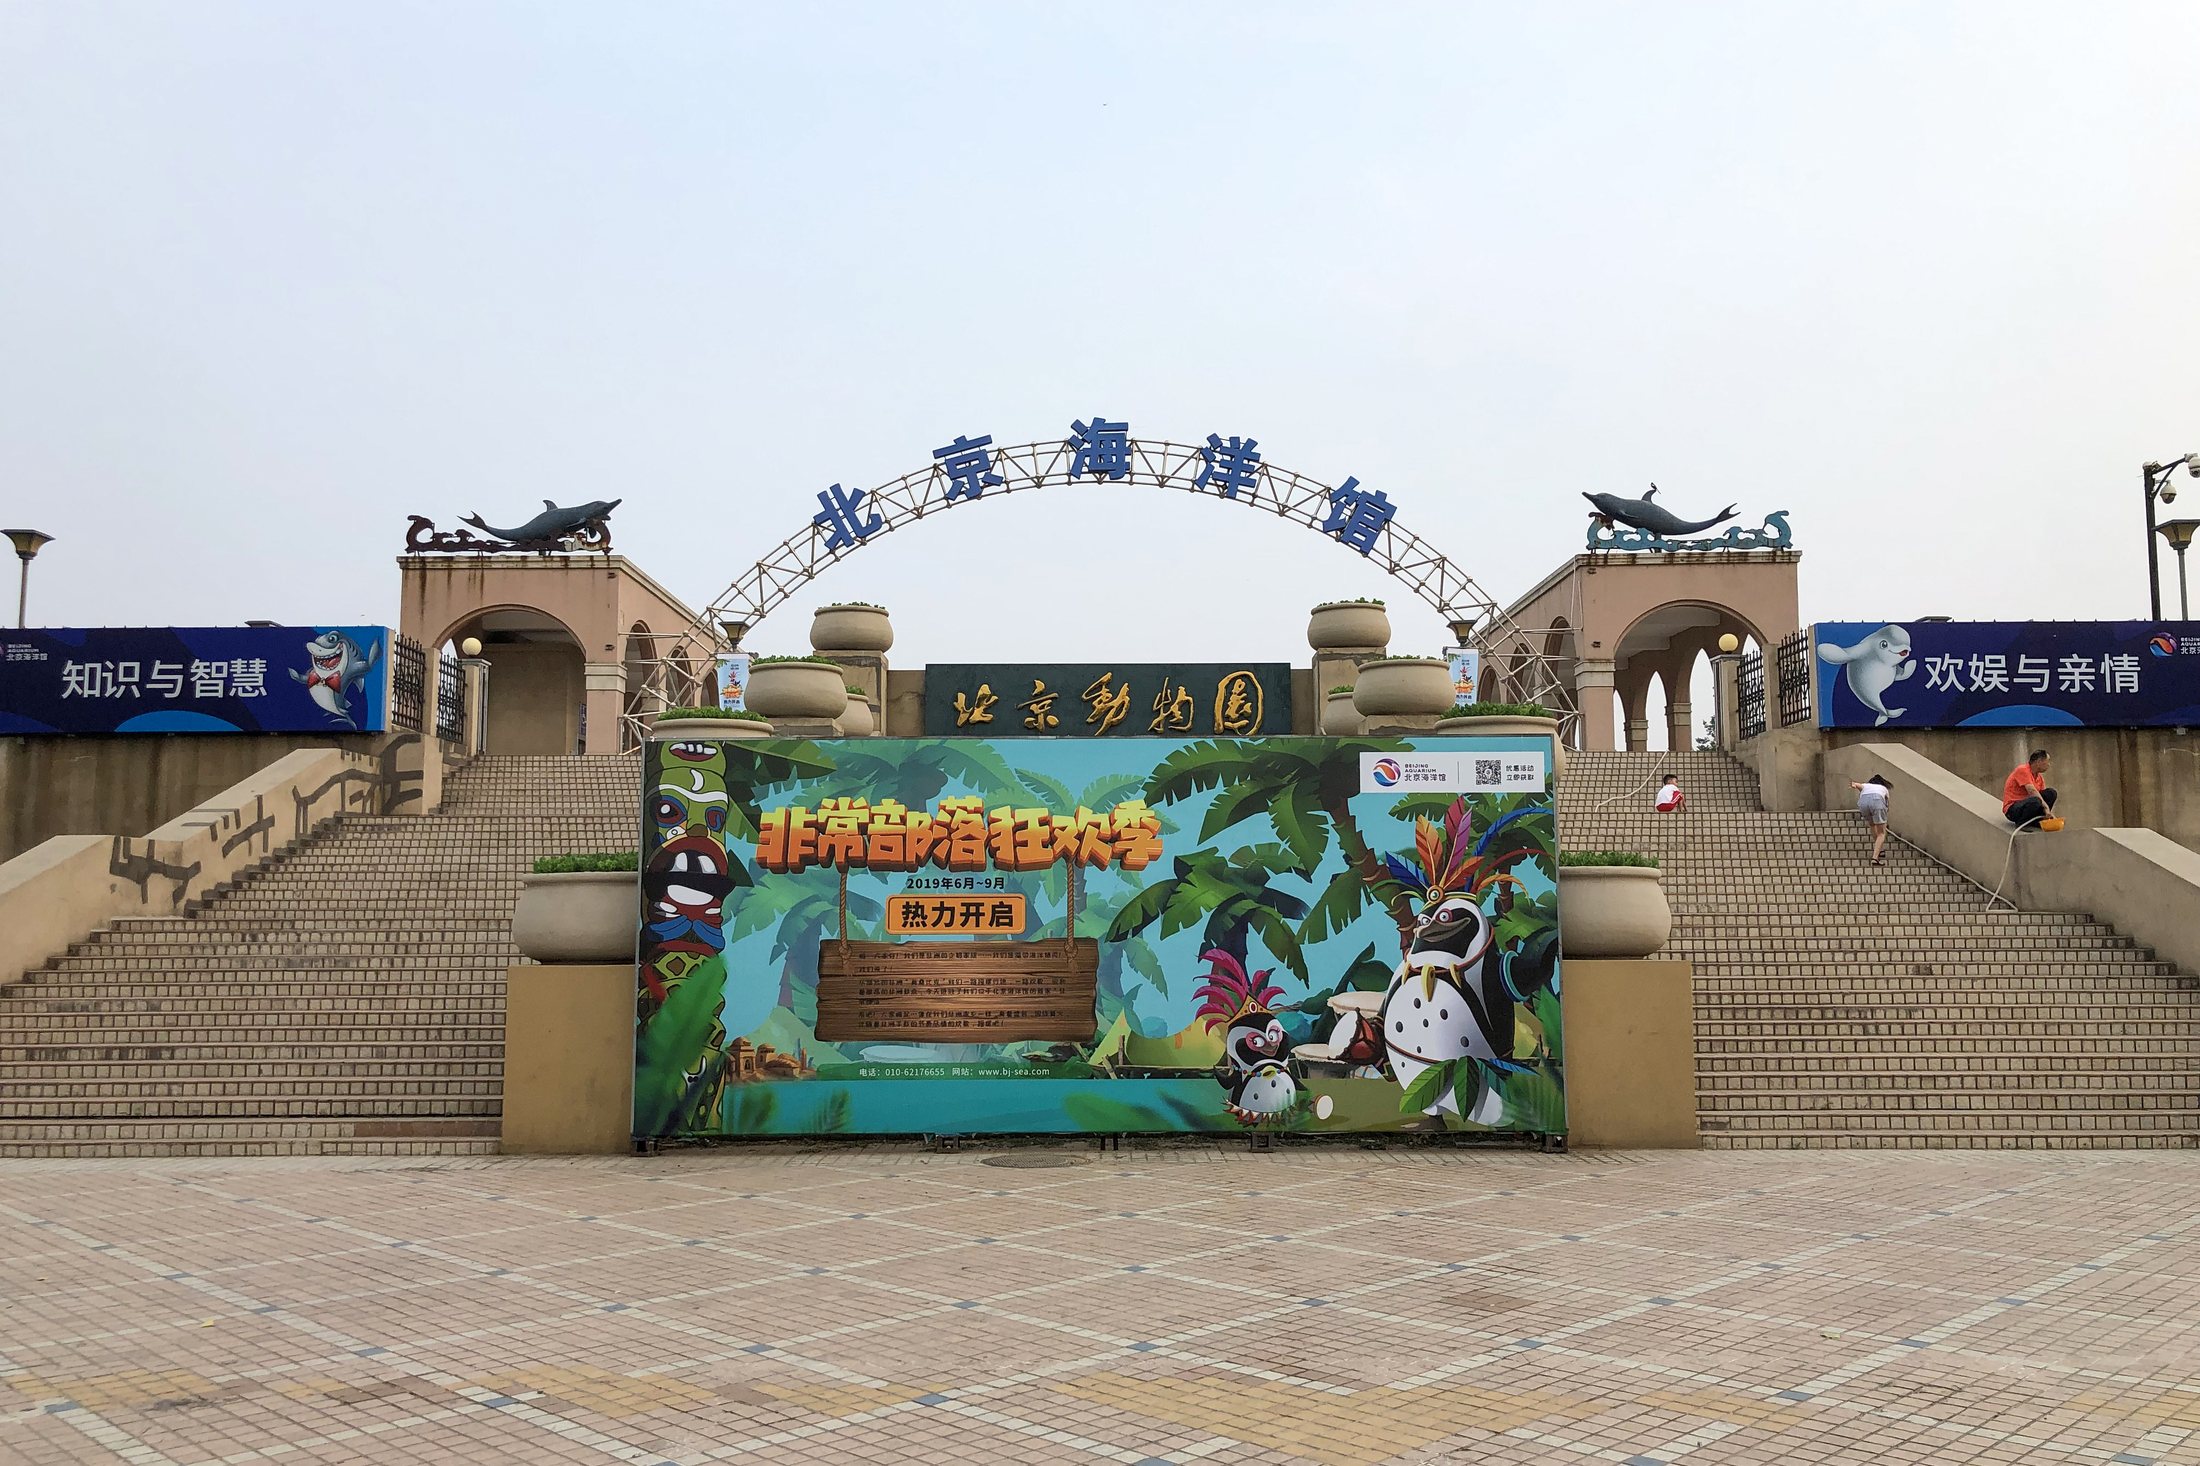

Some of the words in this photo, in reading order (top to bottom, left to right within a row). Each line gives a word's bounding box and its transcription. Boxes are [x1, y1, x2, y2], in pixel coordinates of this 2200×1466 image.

[814, 417, 1398, 554] 北京海洋馆
[62, 658, 268, 699] 知识与智慧
[1924, 653, 2141, 694] 欢娱与亲情
[1404, 773, 1446, 782] 北京海洋馆
[755, 796, 1163, 873] 非常部落狂欢季
[901, 901, 1014, 928] 热力开启
